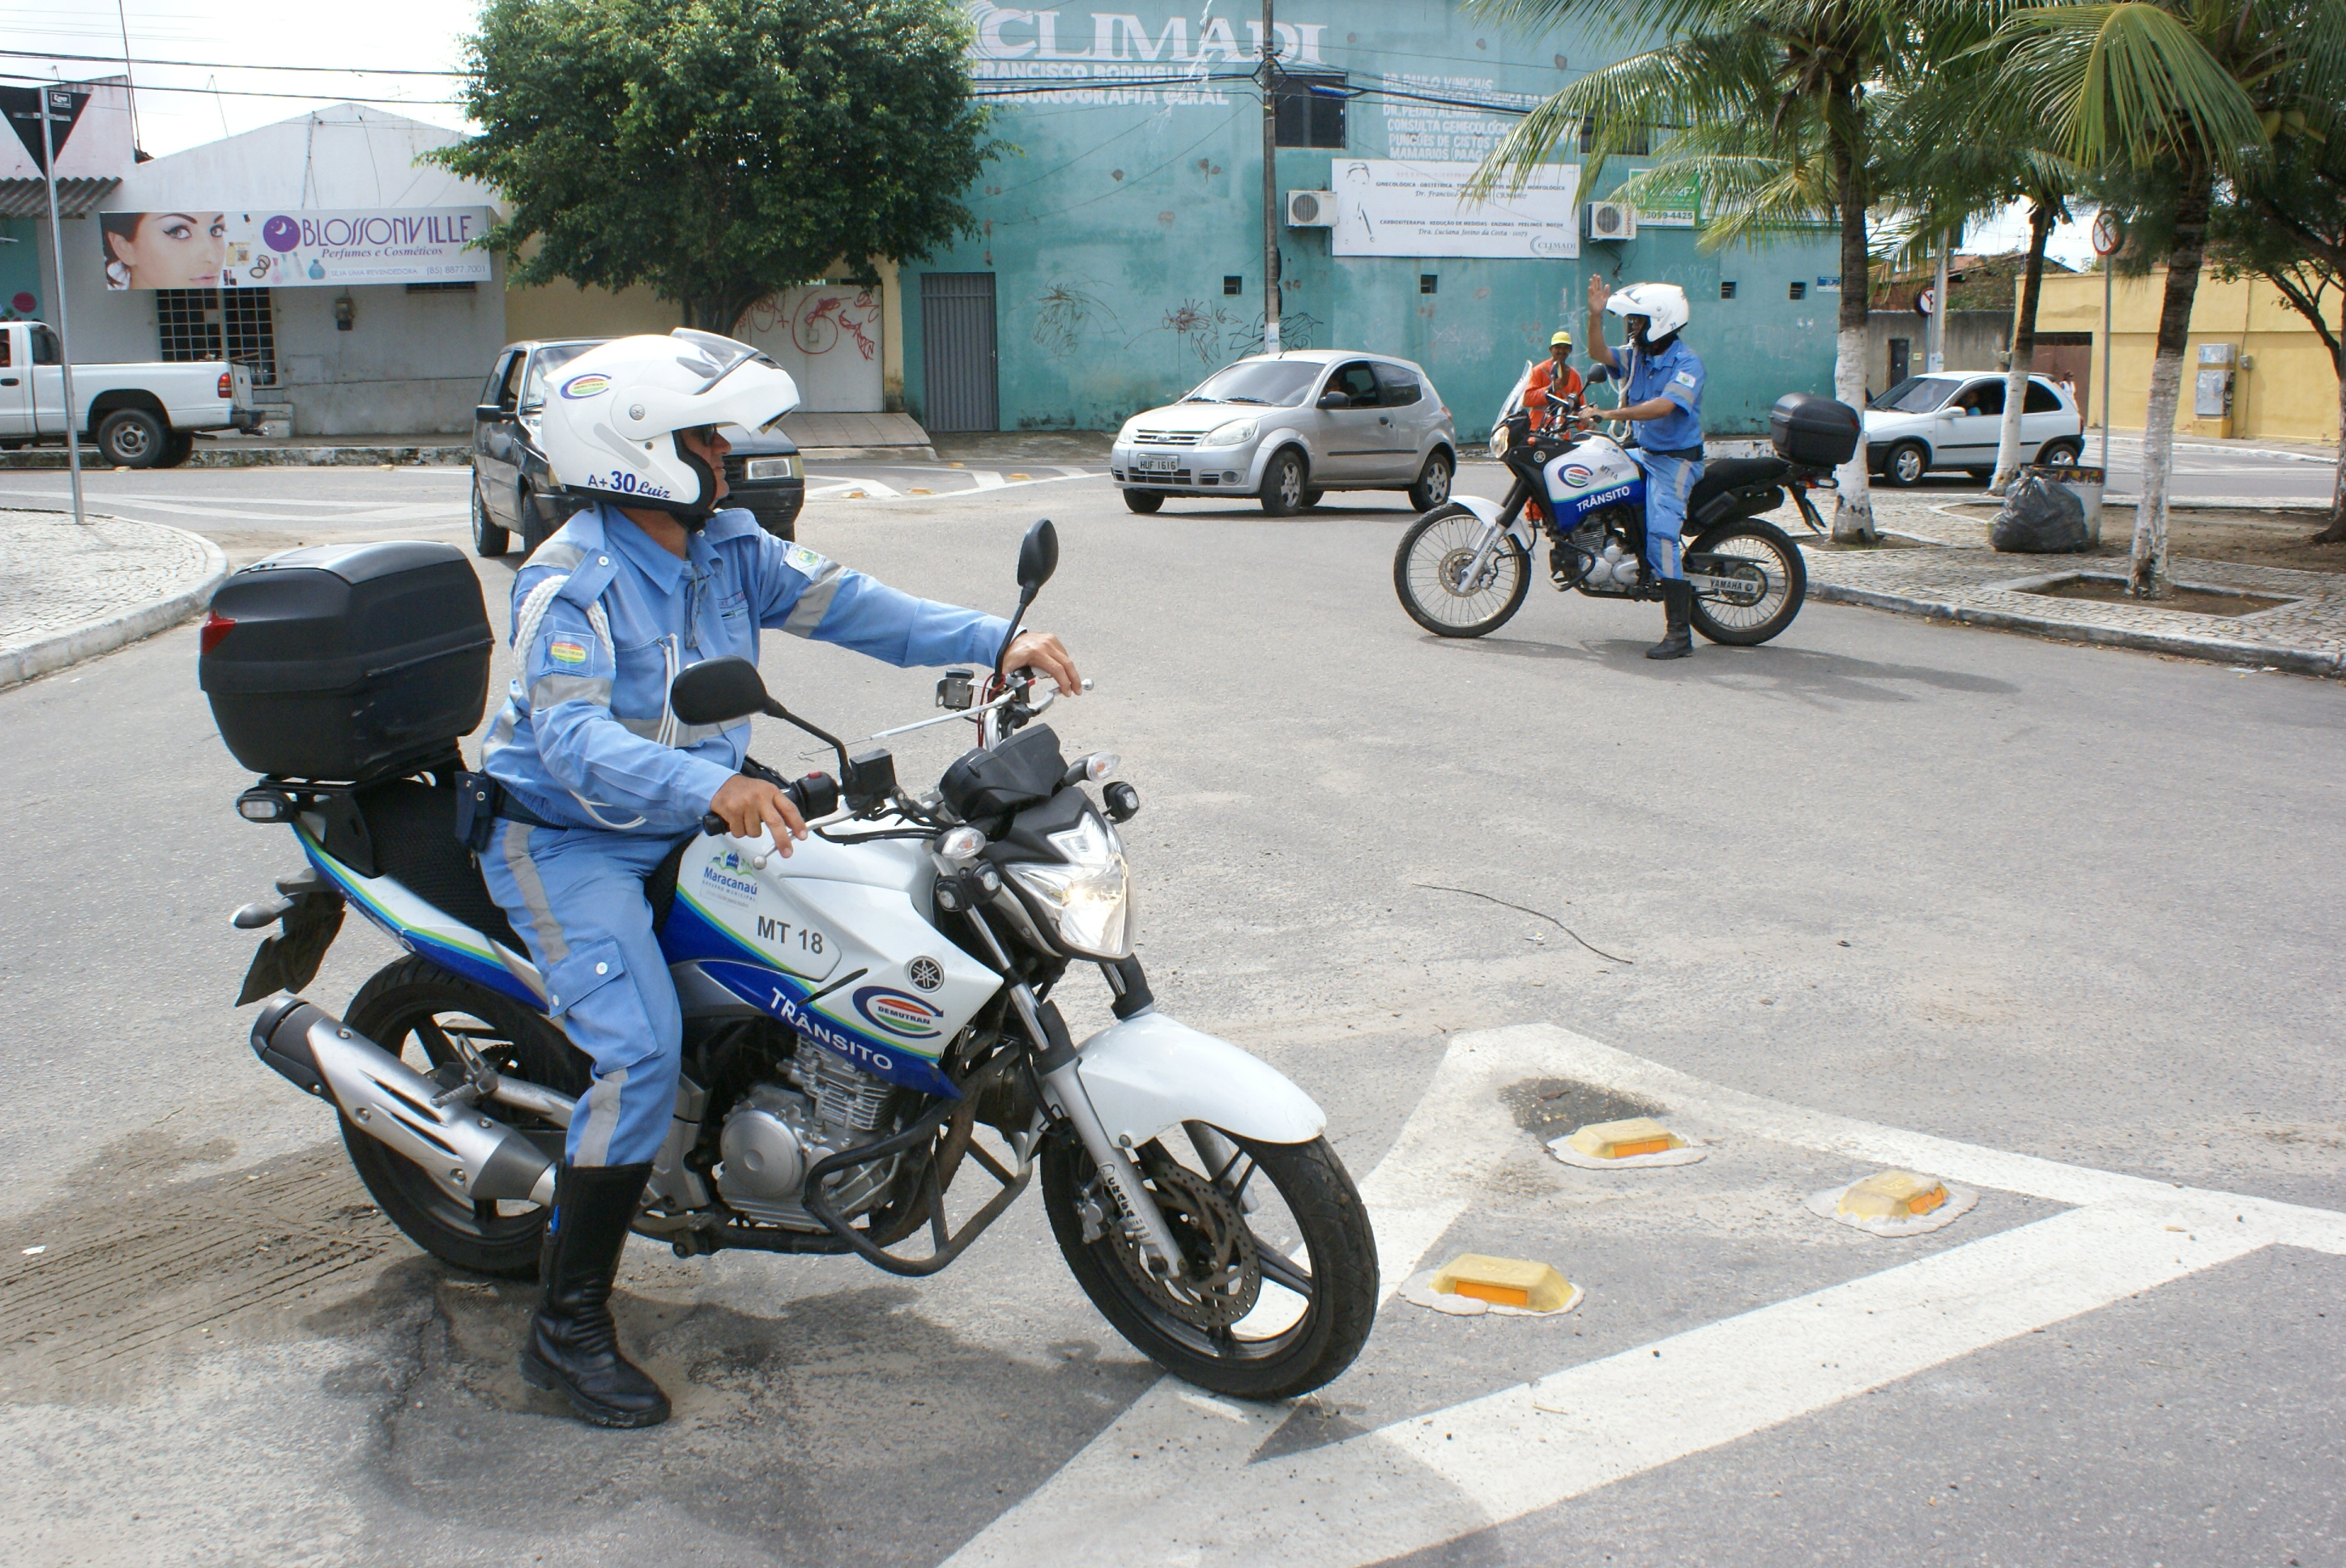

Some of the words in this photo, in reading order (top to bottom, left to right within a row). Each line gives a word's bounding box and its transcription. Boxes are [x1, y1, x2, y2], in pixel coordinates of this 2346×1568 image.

[980, 8, 1328, 65] CLIMADI
[1163, 87, 1229, 104] GERAL
[1387, 118, 1440, 132] CONSULTA
[1442, 119, 1515, 134] GENECOLÓGIC
[1388, 132, 1435, 147] PUNÇÕES
[1436, 134, 1450, 147] DE
[1453, 135, 1491, 148] CISTOS
[1389, 147, 1449, 160] MAMARIOS
[302, 215, 472, 246] BLOSSONVILLE
[1429, 219, 1455, 227] REDUÇÃO
[322, 248, 372, 261] Perfumes
[384, 245, 443, 258] Cosméticos
[1538, 241, 1576, 250] CLIMADI
[366, 268, 418, 276] REVENDEDORA
[426, 265, 443, 275] (85)
[445, 265, 486, 275] 8877.7001
[1140, 461, 1154, 470] HUF
[1158, 461, 1176, 470] 1616
[1599, 464, 1610, 475] MT
[610, 471, 636, 493] 30
[636, 481, 672, 499] Luiz
[1576, 486, 1631, 512] TRÂNSITO
[703, 867, 757, 895] Maracanaú
[757, 915, 791, 944] MT
[798, 928, 824, 955] 18
[877, 1005, 931, 1025] DEMUTRAN
[770, 986, 894, 1071] TRÂNSITO
